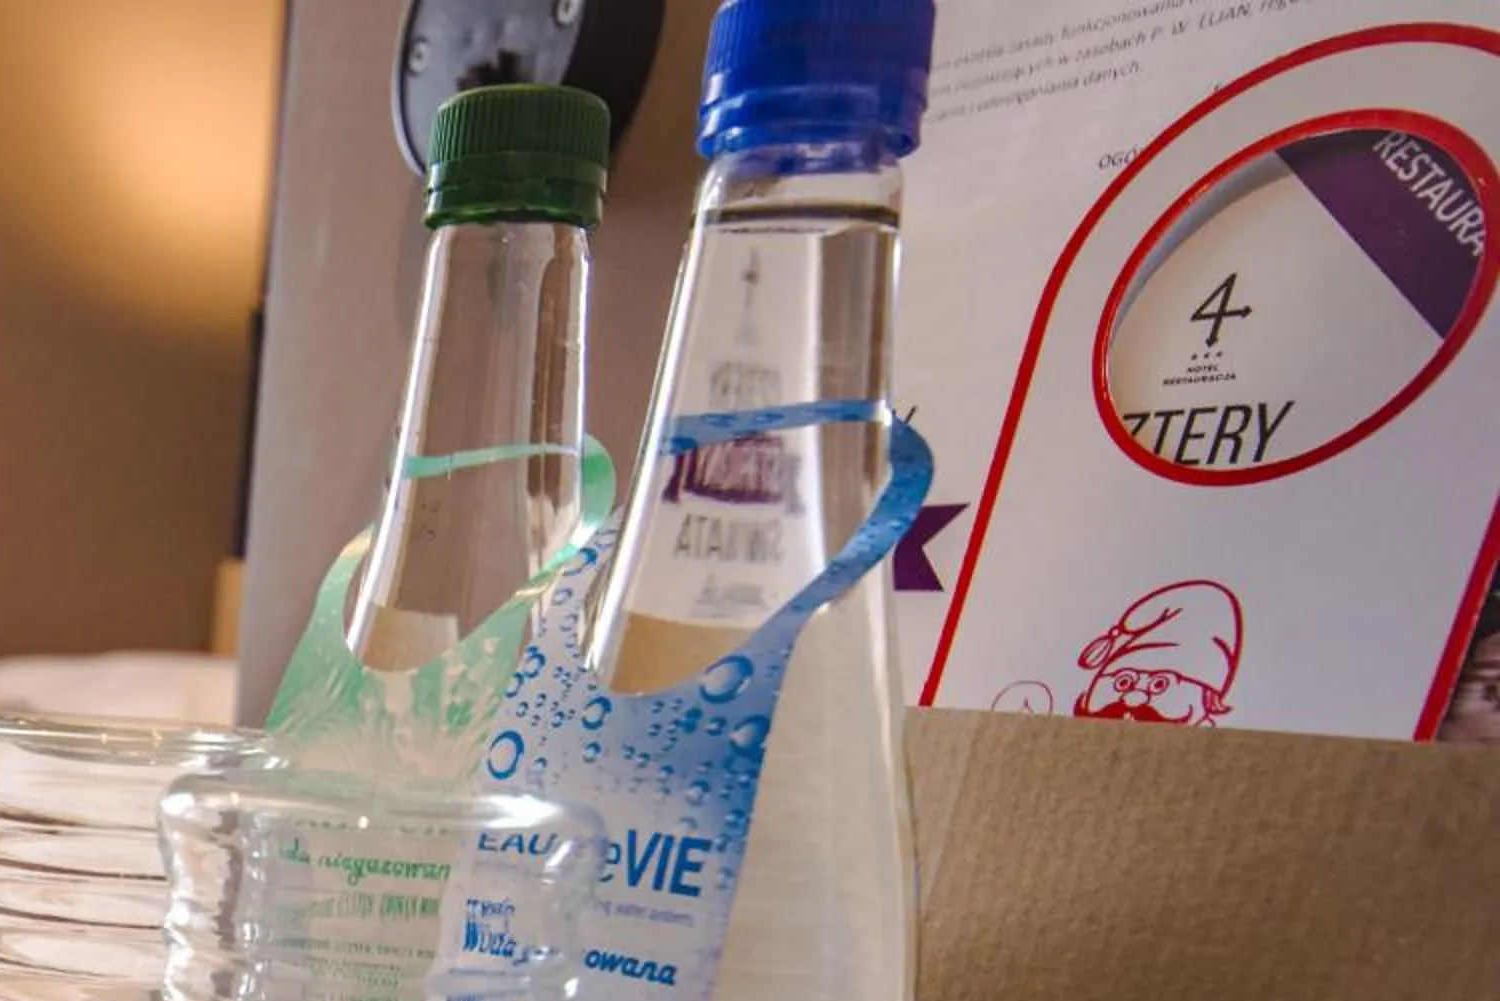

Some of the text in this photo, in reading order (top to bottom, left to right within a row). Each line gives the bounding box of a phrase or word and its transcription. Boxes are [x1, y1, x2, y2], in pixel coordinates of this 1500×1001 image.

[1186, 364, 1219, 374] HOTEL
[1162, 373, 1238, 387] RESTAURACJA
[477, 830, 559, 857] EAU
